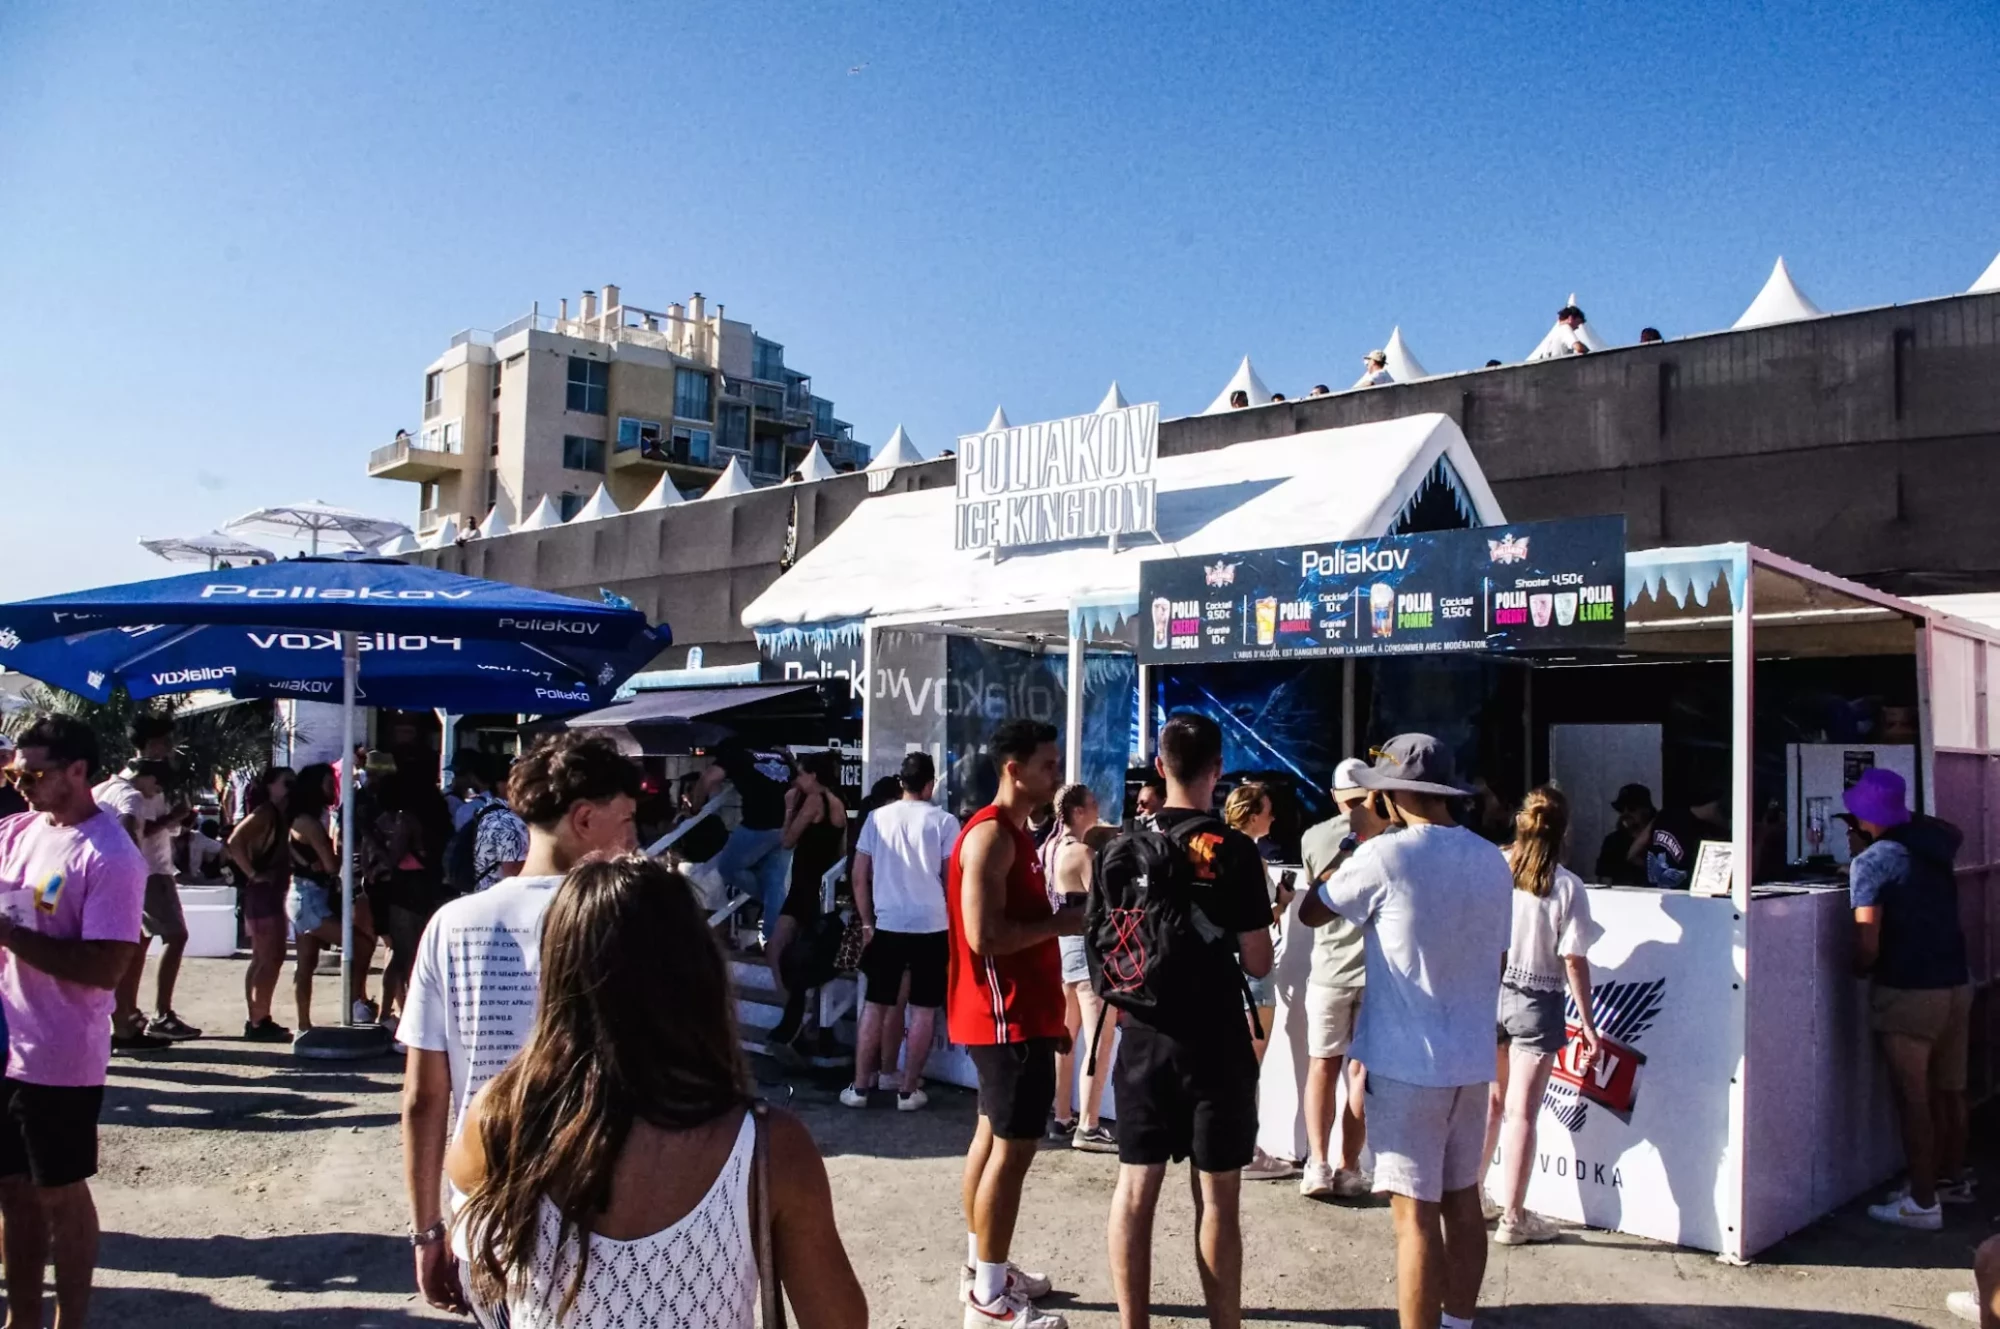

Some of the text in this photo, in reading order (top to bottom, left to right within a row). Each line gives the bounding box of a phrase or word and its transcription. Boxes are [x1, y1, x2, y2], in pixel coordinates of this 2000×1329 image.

[957, 404, 1157, 499] POLIAKOV
[955, 479, 1157, 550] ICE KINGDOM
[1302, 546, 1410, 577] Poliakov
[201, 584, 472, 599] Poliakov
[1515, 578, 1550, 589] Shooter
[1319, 592, 1348, 602] Cocktail
[1398, 593, 1433, 613] POLIA
[1440, 596, 1474, 607] Cocktail
[1495, 591, 1527, 609] POLIA
[1579, 585, 1613, 604] POLIA
[1172, 600, 1199, 618] POLIA
[1205, 600, 1232, 611] Cocktail
[1280, 602, 1312, 621] POLIA
[1580, 603, 1613, 621] LIME
[499, 608, 600, 635] Poliakov
[1171, 619, 1199, 635] CHERRY
[1398, 613, 1433, 629] POMME
[1181, 635, 1199, 649] COLA
[1233, 651, 1253, 660] L'ABUS
[1254, 649, 1281, 659] D'ALCOOL
[1282, 648, 1292, 657] EST
[1294, 647, 1327, 657] DANGEREUX
[1328, 646, 1344, 655] POUR
[1346, 646, 1354, 654] LA
[1384, 642, 1424, 653] CONSOMMER
[1425, 642, 1442, 651] AVEC
[535, 688, 591, 702] Poliako
[1540, 1154, 1623, 1188] VODKA
